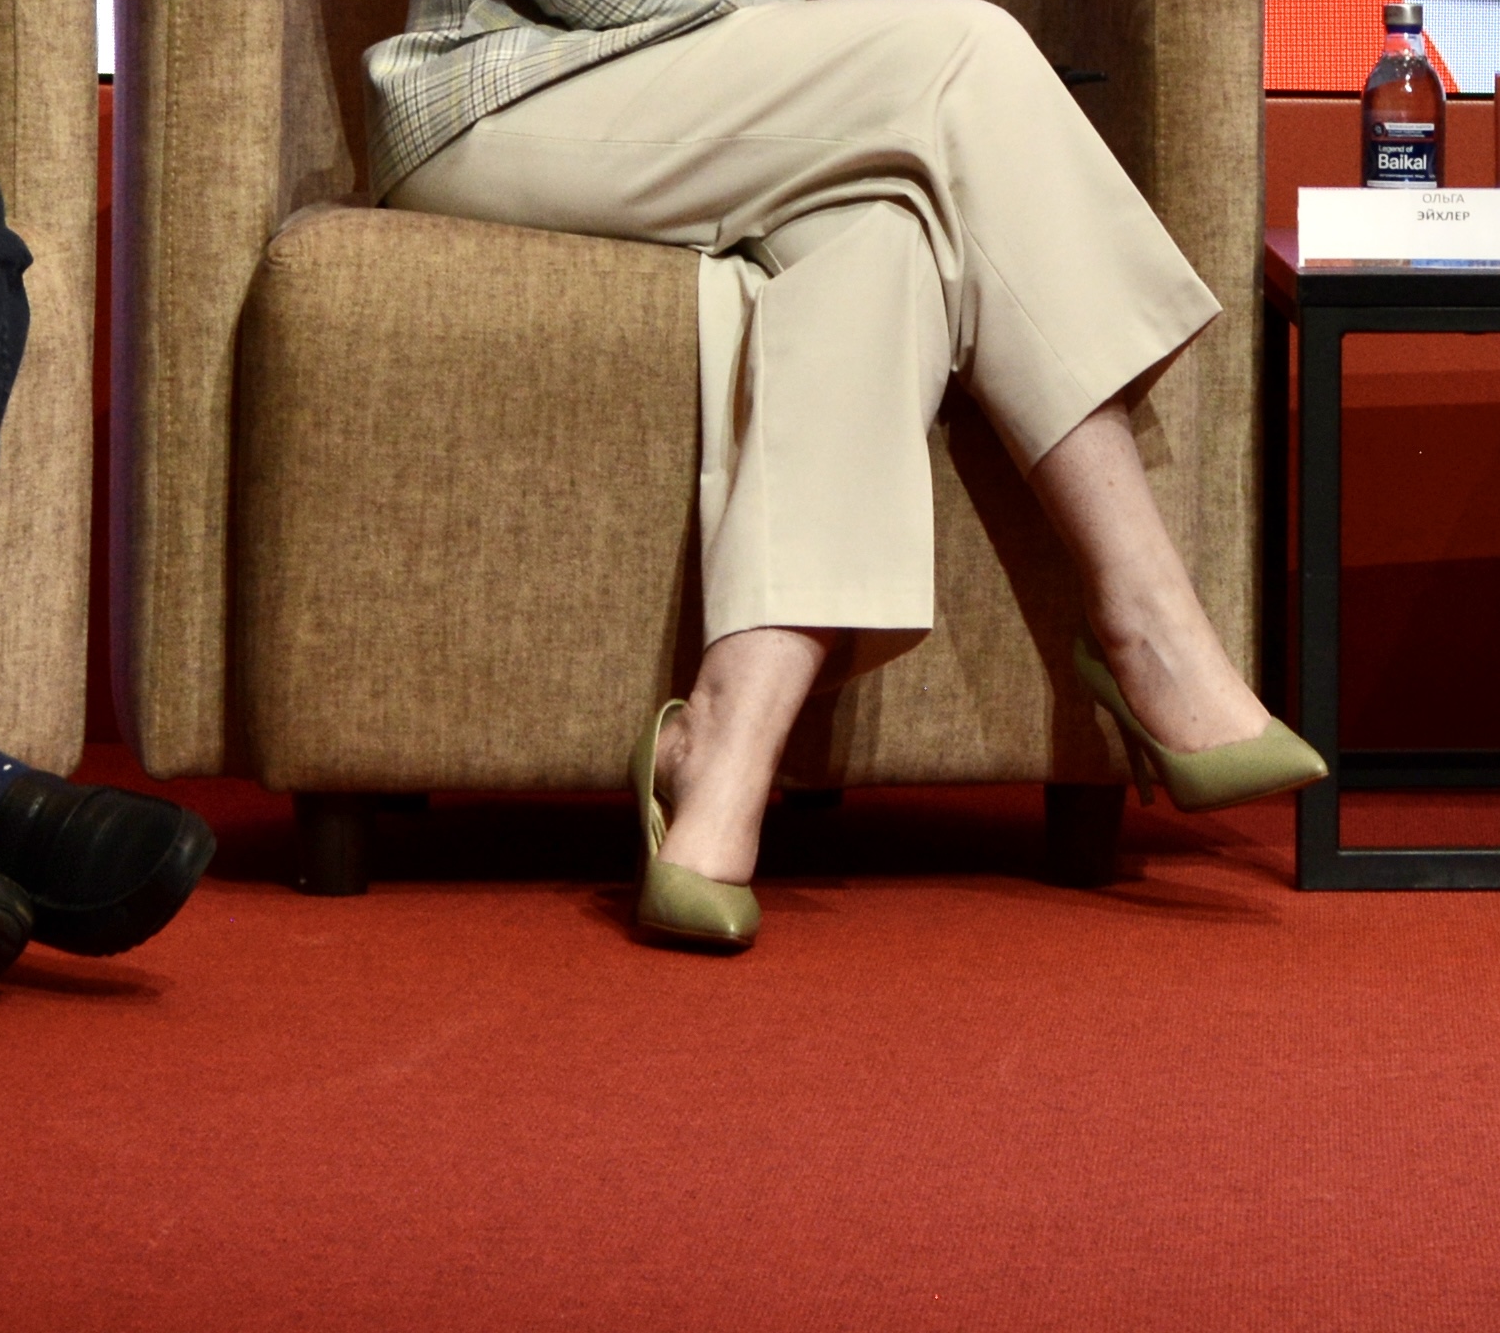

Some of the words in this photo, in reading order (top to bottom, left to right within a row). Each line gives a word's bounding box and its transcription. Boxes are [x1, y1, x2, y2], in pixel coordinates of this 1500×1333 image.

[1378, 153, 1427, 170] Baikal
[1422, 192, 1465, 204] ОЛЬГА
[1416, 209, 1471, 222] ЭЙХЛЕР
